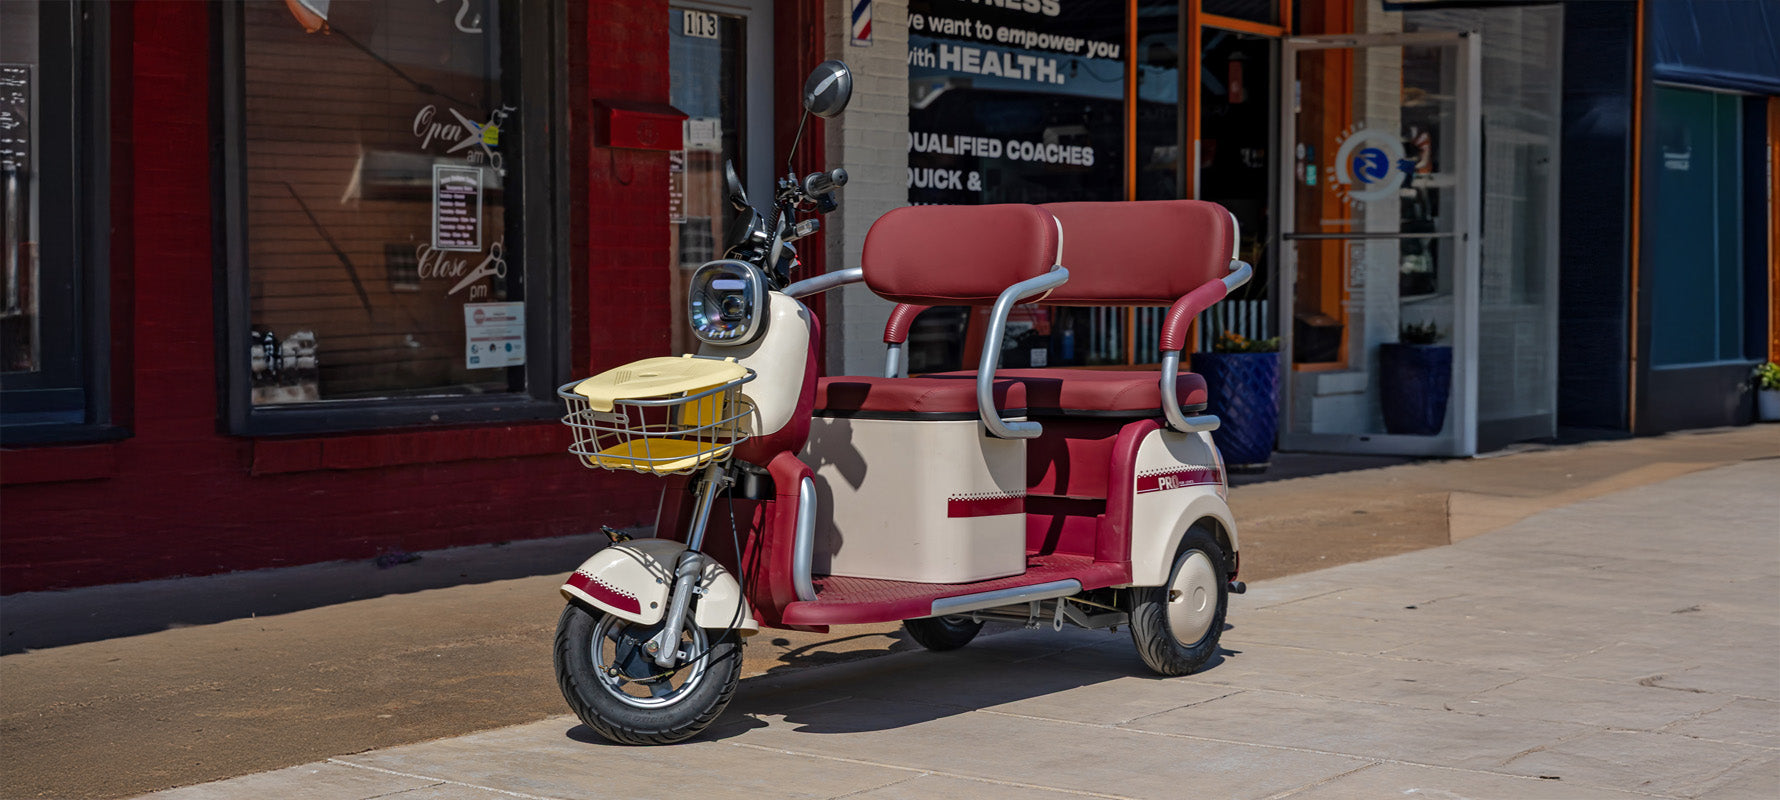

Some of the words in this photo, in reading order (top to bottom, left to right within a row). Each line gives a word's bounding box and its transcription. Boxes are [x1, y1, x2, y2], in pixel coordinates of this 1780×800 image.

[687, 13, 716, 36] 113
[928, 15, 972, 37] want
[975, 20, 993, 40] to
[996, 26, 1085, 53] empower
[1086, 40, 1120, 59] you
[939, 44, 1065, 85] HEALTH.
[413, 104, 461, 150] Open
[466, 150, 484, 164] am
[1006, 140, 1095, 167] COACHES
[967, 171, 982, 191] &
[416, 243, 467, 279] Close
[469, 284, 487, 301] pm
[1158, 475, 1180, 491] PRO
